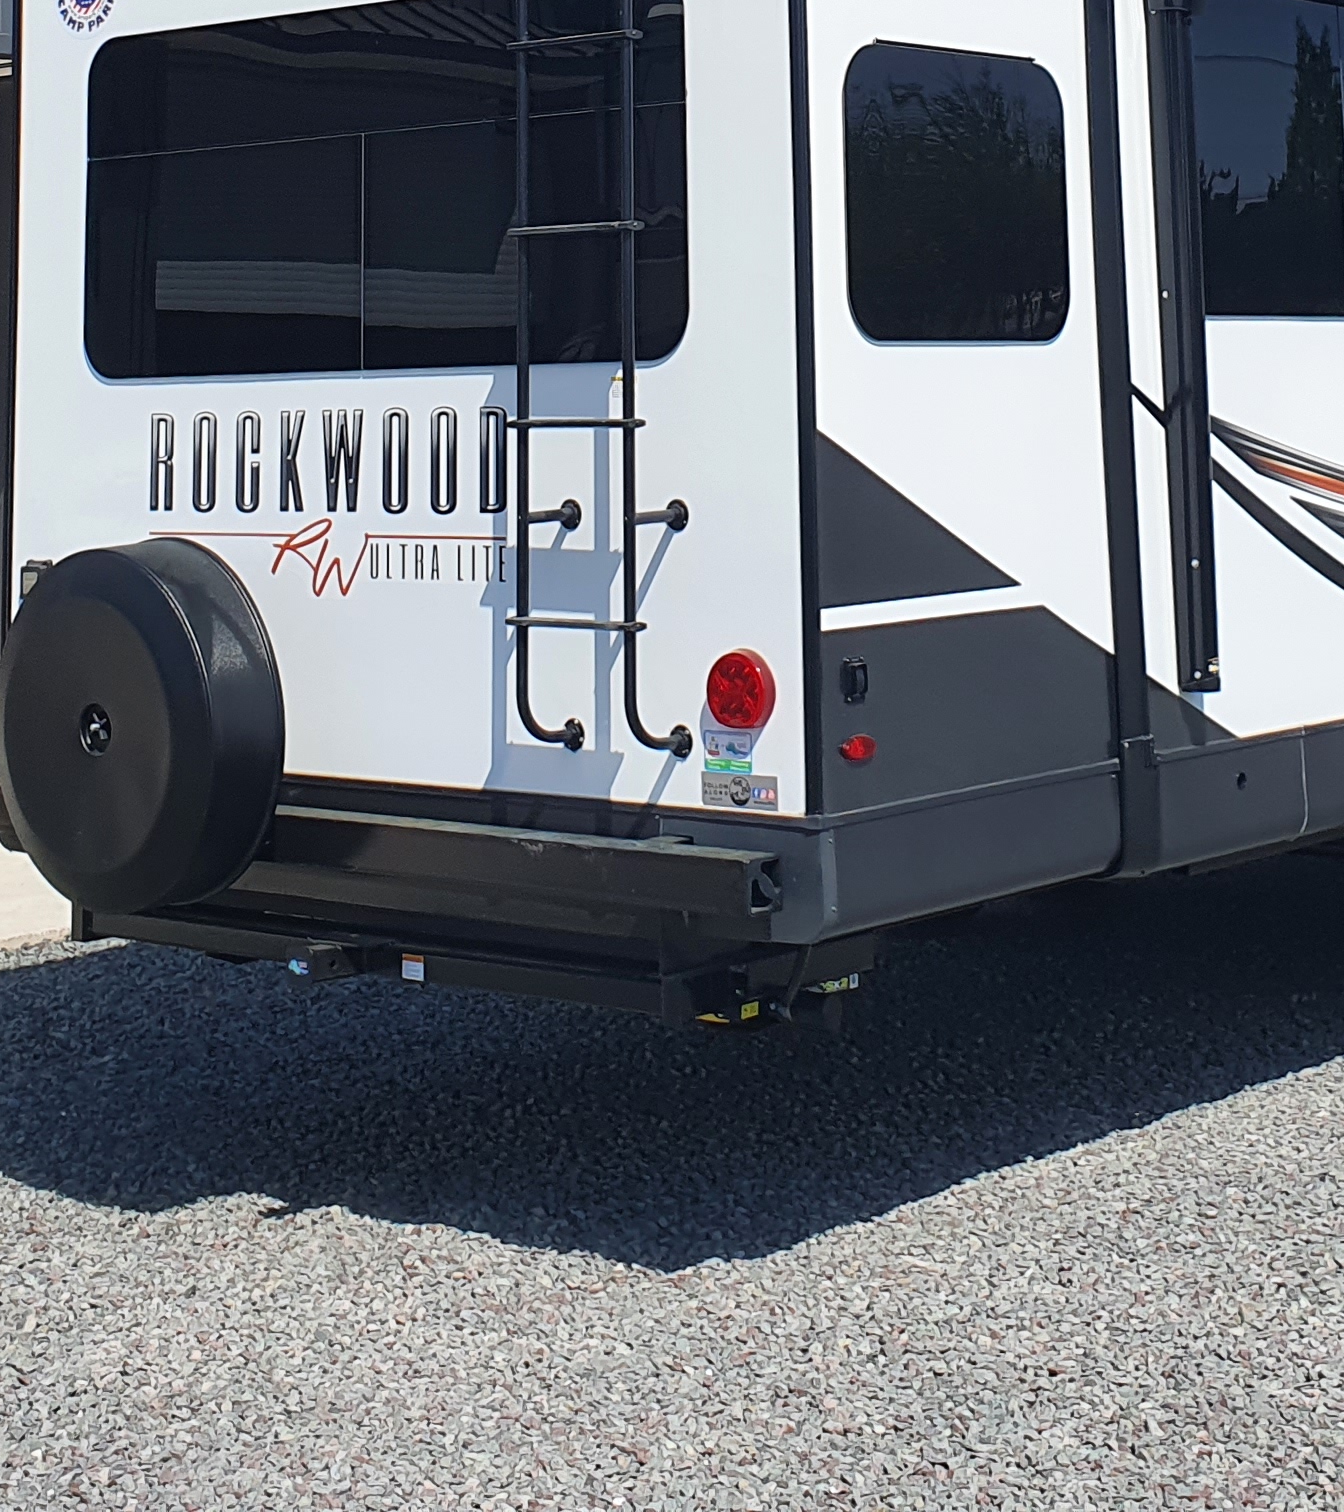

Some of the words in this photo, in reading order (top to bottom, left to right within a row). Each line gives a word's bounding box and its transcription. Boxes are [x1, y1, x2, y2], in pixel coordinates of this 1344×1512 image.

[149, 406, 508, 515] ROCKWOOD
[271, 518, 369, 597] RW
[369, 543, 443, 580] ULTRA
[457, 544, 507, 583] LITE
